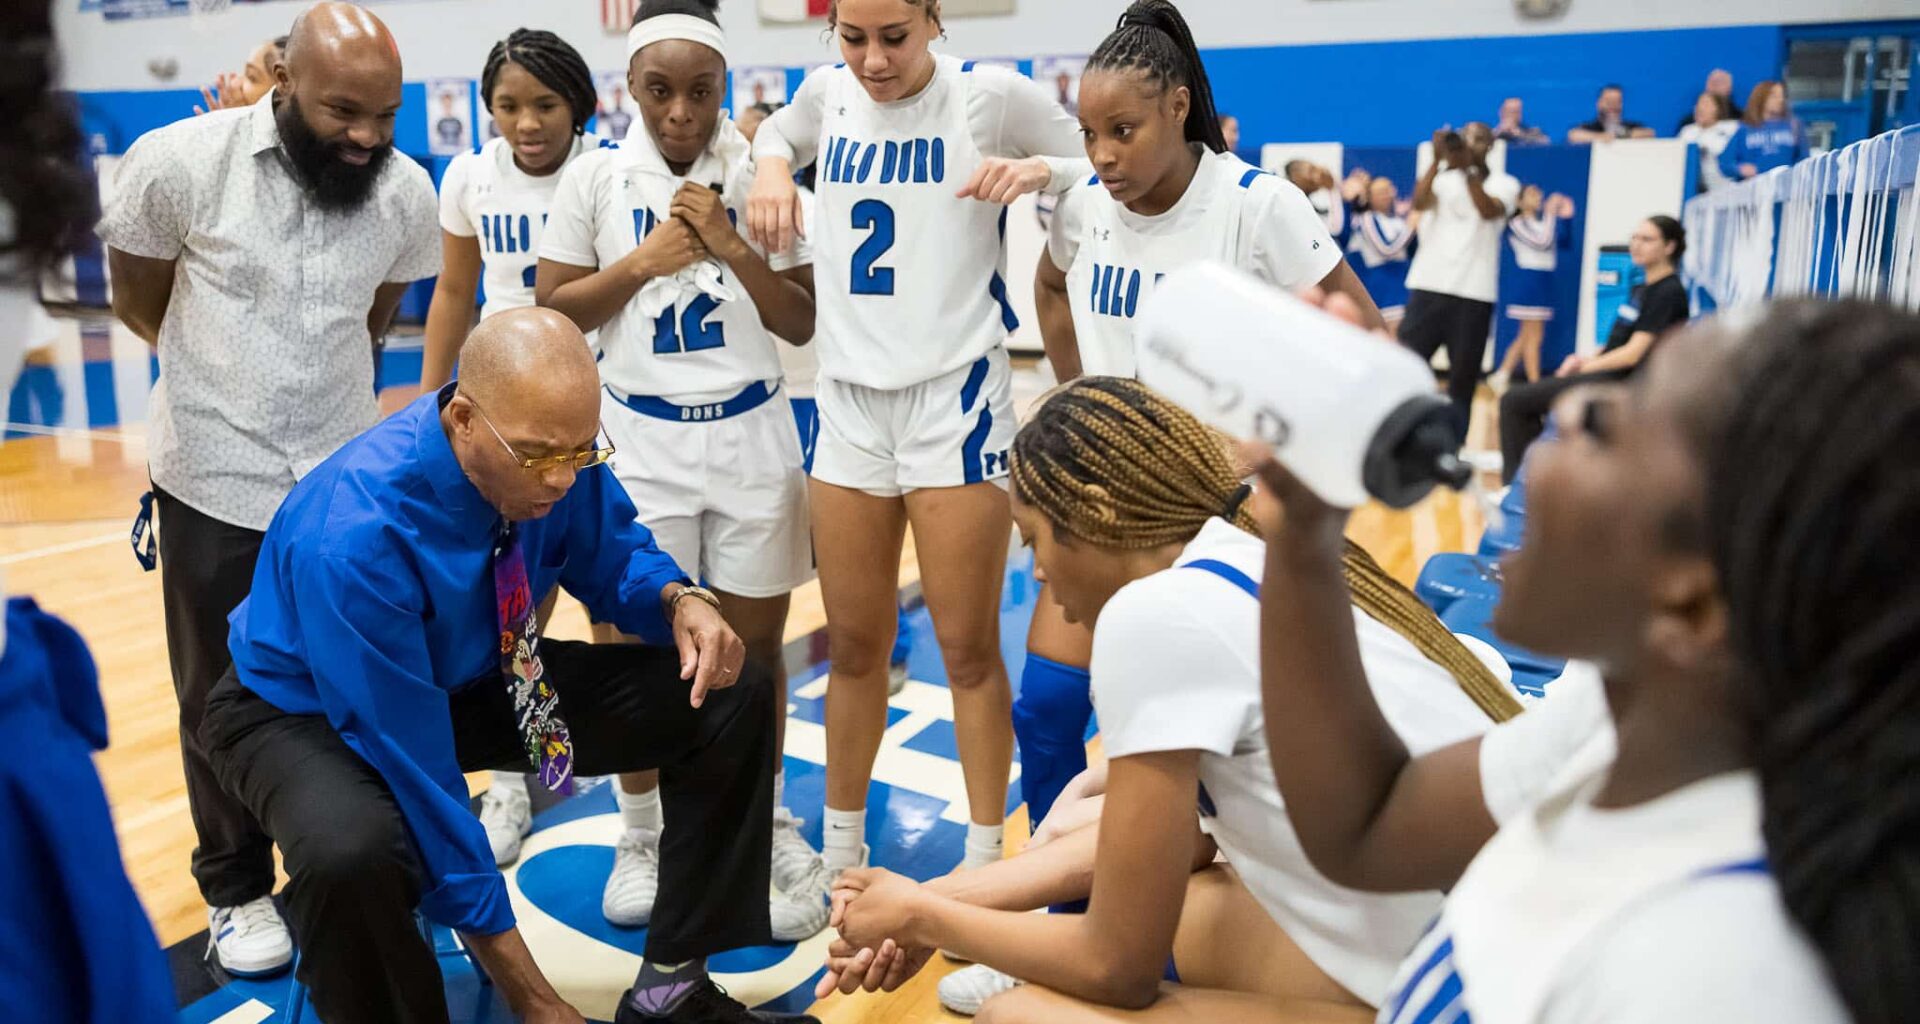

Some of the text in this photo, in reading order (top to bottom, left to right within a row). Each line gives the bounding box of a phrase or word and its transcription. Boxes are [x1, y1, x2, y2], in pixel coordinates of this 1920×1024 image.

[822, 135, 945, 184] PALO DURO
[480, 213, 531, 253] PALO
[849, 198, 896, 297] 2
[1090, 262, 1141, 319] PALO
[681, 403, 724, 421] DONS
